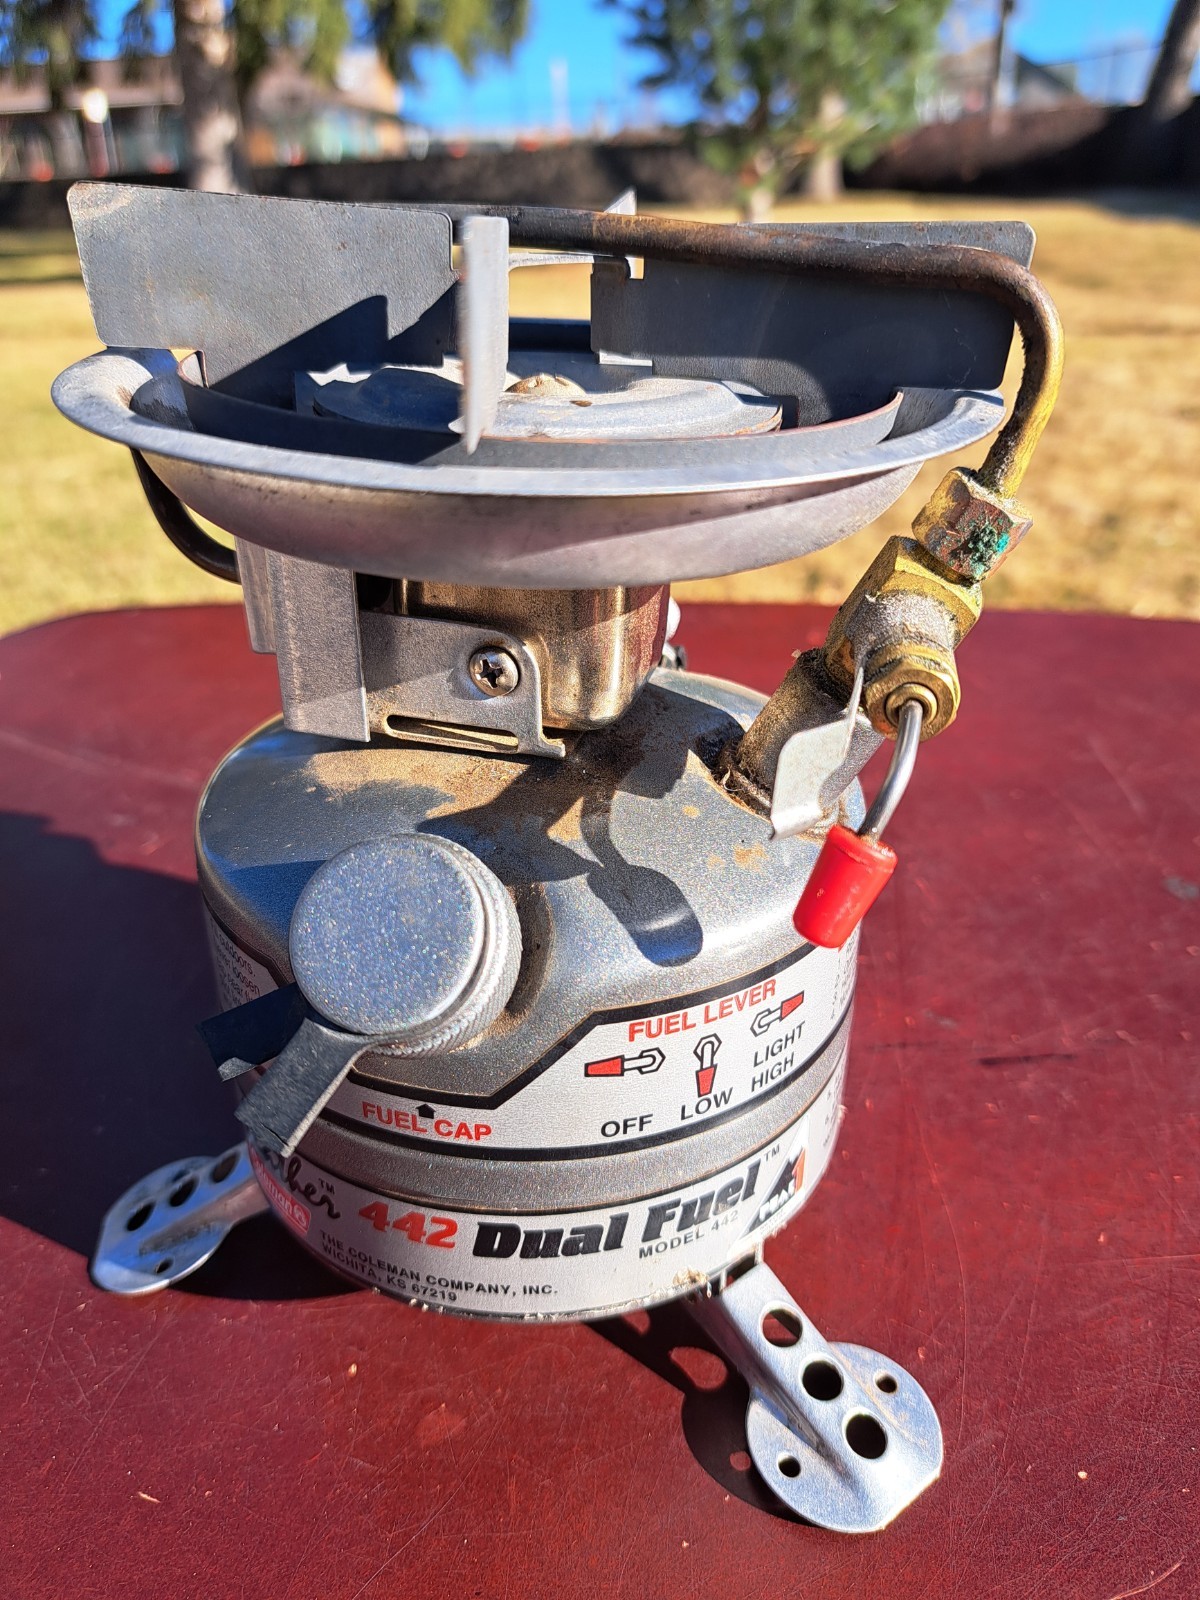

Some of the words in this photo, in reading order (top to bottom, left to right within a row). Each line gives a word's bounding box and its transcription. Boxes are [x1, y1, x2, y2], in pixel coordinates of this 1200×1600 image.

[628, 1012, 697, 1042] FUEL
[703, 979, 776, 1024] LEVER
[753, 1021, 807, 1068] LIGHT
[751, 1051, 795, 1092] HIGH
[362, 1101, 427, 1133] FUEL
[434, 1119, 492, 1140] CAP
[600, 1113, 653, 1137] OFF
[680, 1087, 733, 1121] LOW
[358, 1201, 459, 1249] 442
[472, 1212, 629, 1260] Dual
[641, 1158, 762, 1243] Fuel
[638, 1231, 705, 1259] MODEL
[711, 1210, 739, 1232] 442
[320, 1229, 344, 1251] THE
[349, 1247, 420, 1282] COLEMAN
[426, 1274, 516, 1297] COMPANY,
[523, 1284, 558, 1296] INC.
[322, 1242, 381, 1283] WICHITA,
[387, 1275, 406, 1289] KS
[412, 1284, 457, 1302] 67219
